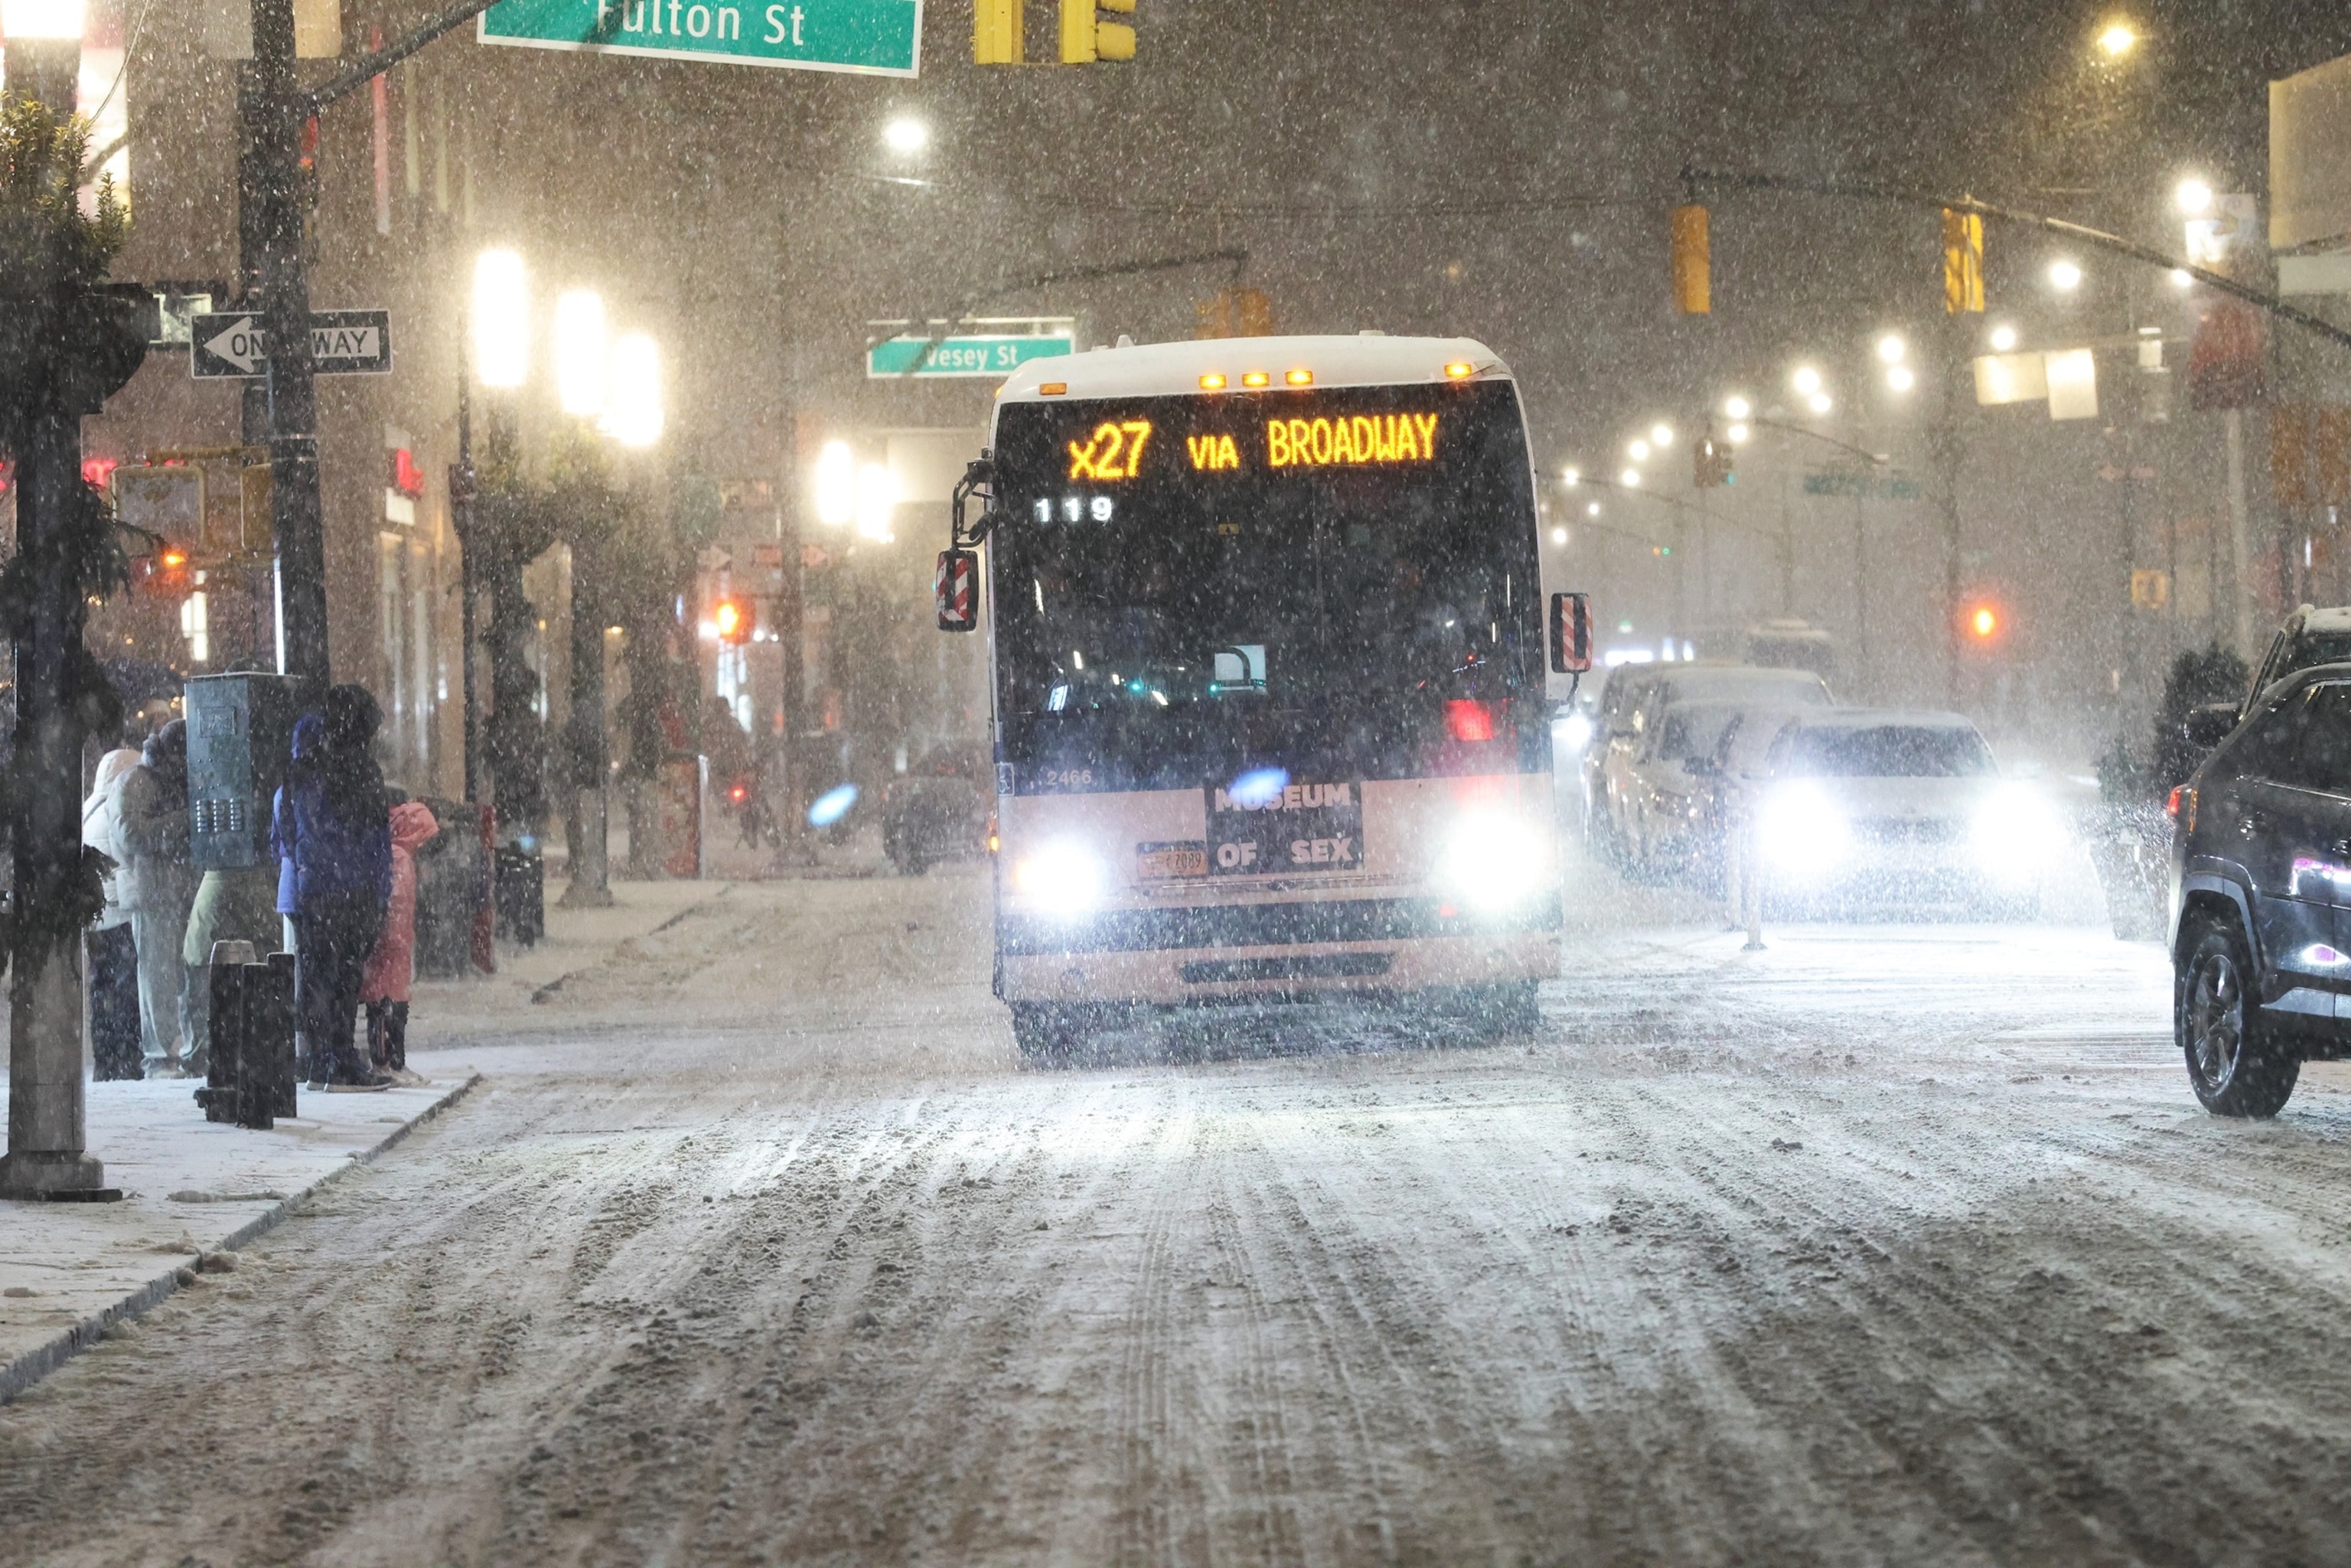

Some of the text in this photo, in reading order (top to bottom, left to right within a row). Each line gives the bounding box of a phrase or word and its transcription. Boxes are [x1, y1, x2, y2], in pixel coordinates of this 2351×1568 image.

[597, 0, 804, 45] Fulton St
[231, 330, 367, 357] ON WAY
[926, 345, 1018, 370] Vesey St
[1187, 435, 1239, 470] VIA
[1268, 412, 1437, 467] BROADWAY
[1046, 769, 1092, 787] 2466
[1217, 838, 1353, 867] OF SEX
